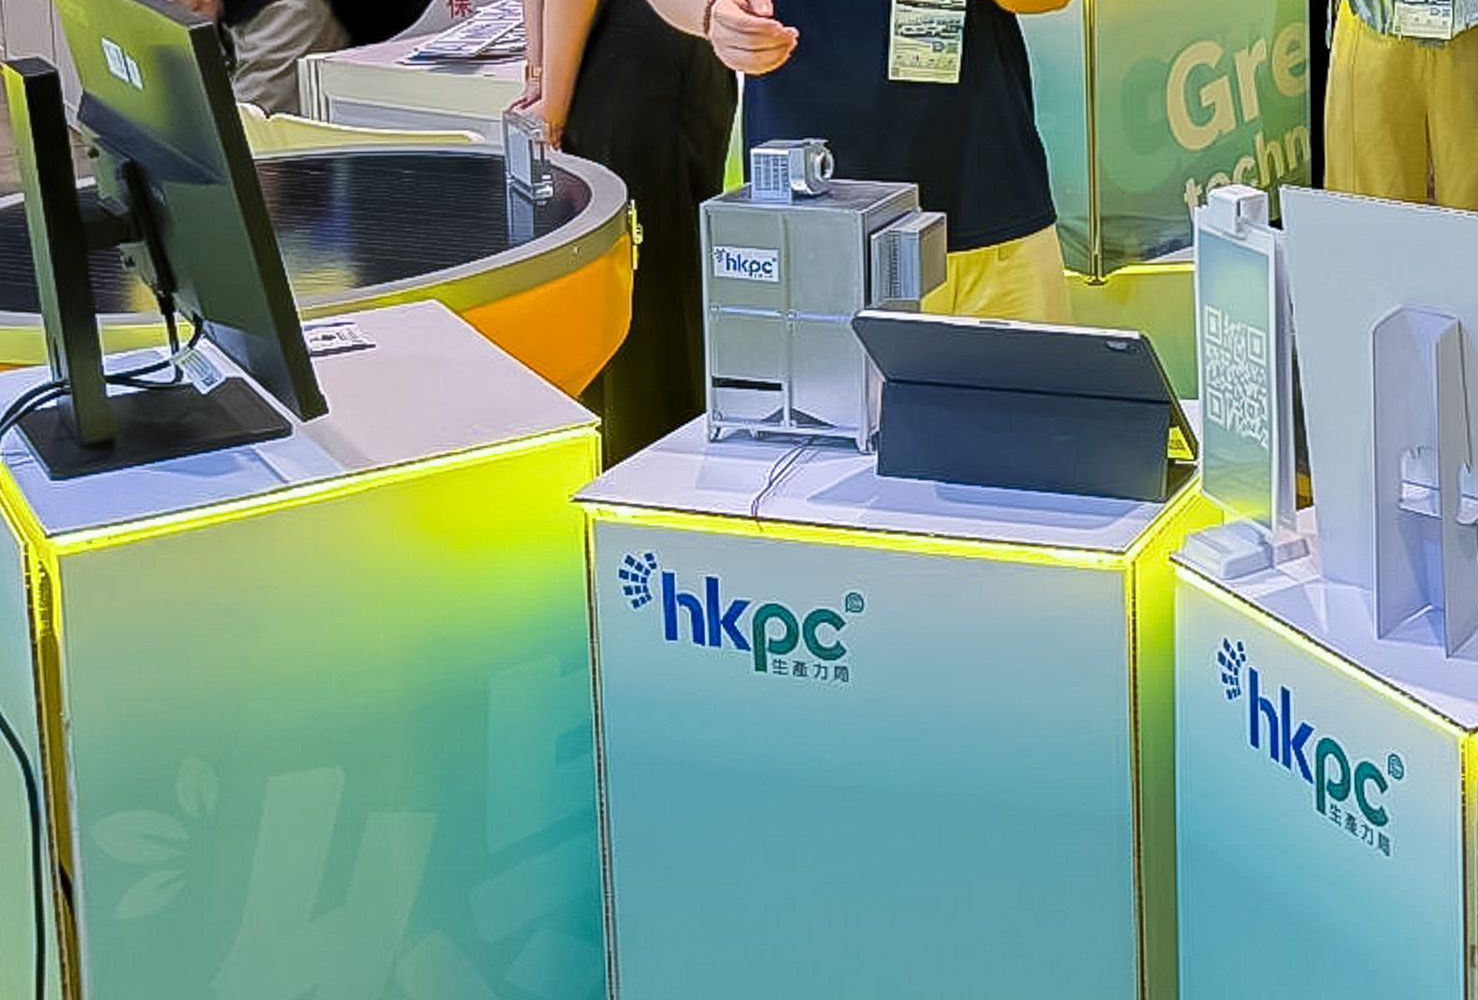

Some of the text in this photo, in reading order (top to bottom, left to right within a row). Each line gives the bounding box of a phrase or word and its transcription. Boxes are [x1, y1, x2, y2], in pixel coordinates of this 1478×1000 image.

[1167, 22, 1309, 150] Gre
[726, 252, 772, 277] hkpc
[661, 571, 847, 672] hkpc
[1249, 667, 1388, 826] hkpc
